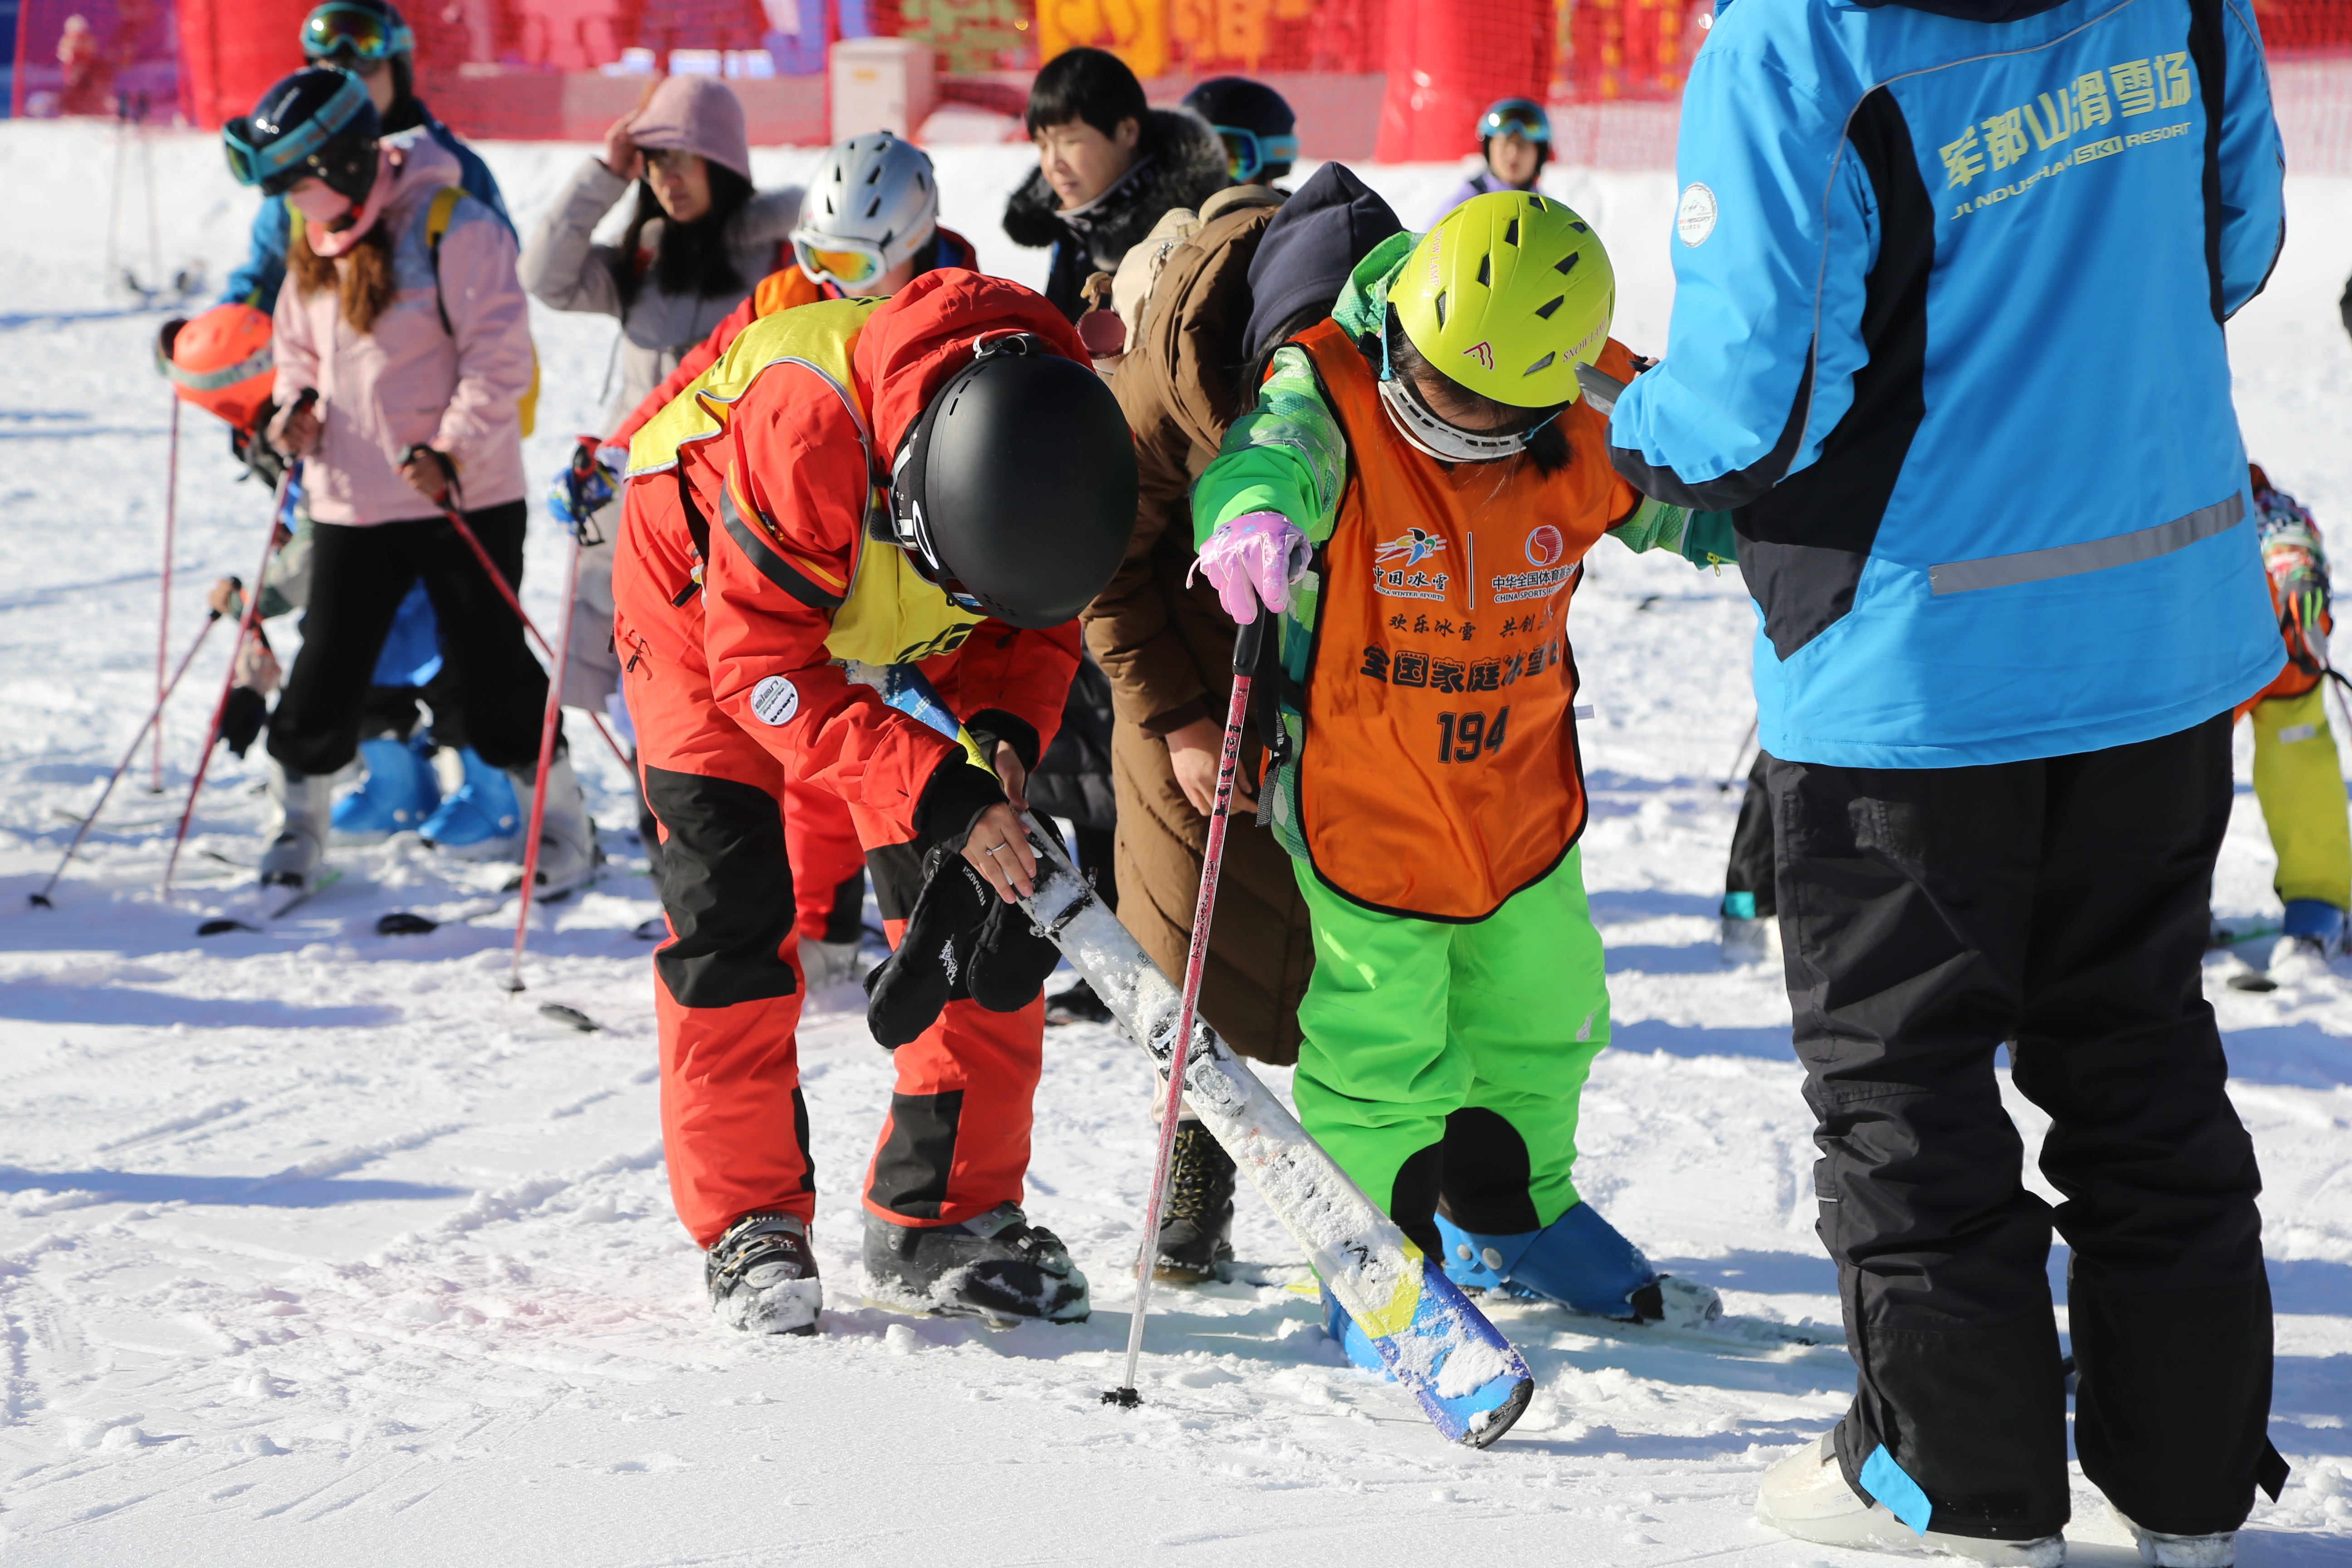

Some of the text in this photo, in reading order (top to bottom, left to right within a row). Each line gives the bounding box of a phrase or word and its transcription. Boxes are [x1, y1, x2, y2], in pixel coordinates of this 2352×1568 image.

[1939, 51, 2191, 190] 军都山滑雪场
[2074, 137, 2122, 164] SKI
[2126, 122, 2191, 147] RESORT
[1430, 227, 1444, 287] SNOW LAMP
[1563, 316, 1608, 363] SNOW LAMP
[1374, 567, 1448, 590] 中国冰雪
[1374, 584, 1390, 595] CHINA
[1495, 589, 1546, 602] CHINA SPORTS
[1389, 614, 1476, 641] 欢乐冰雪
[756, 680, 779, 709] elan
[1437, 706, 1509, 763] 194
[970, 750, 986, 769] SPEED
[1137, 952, 1147, 964] 120
